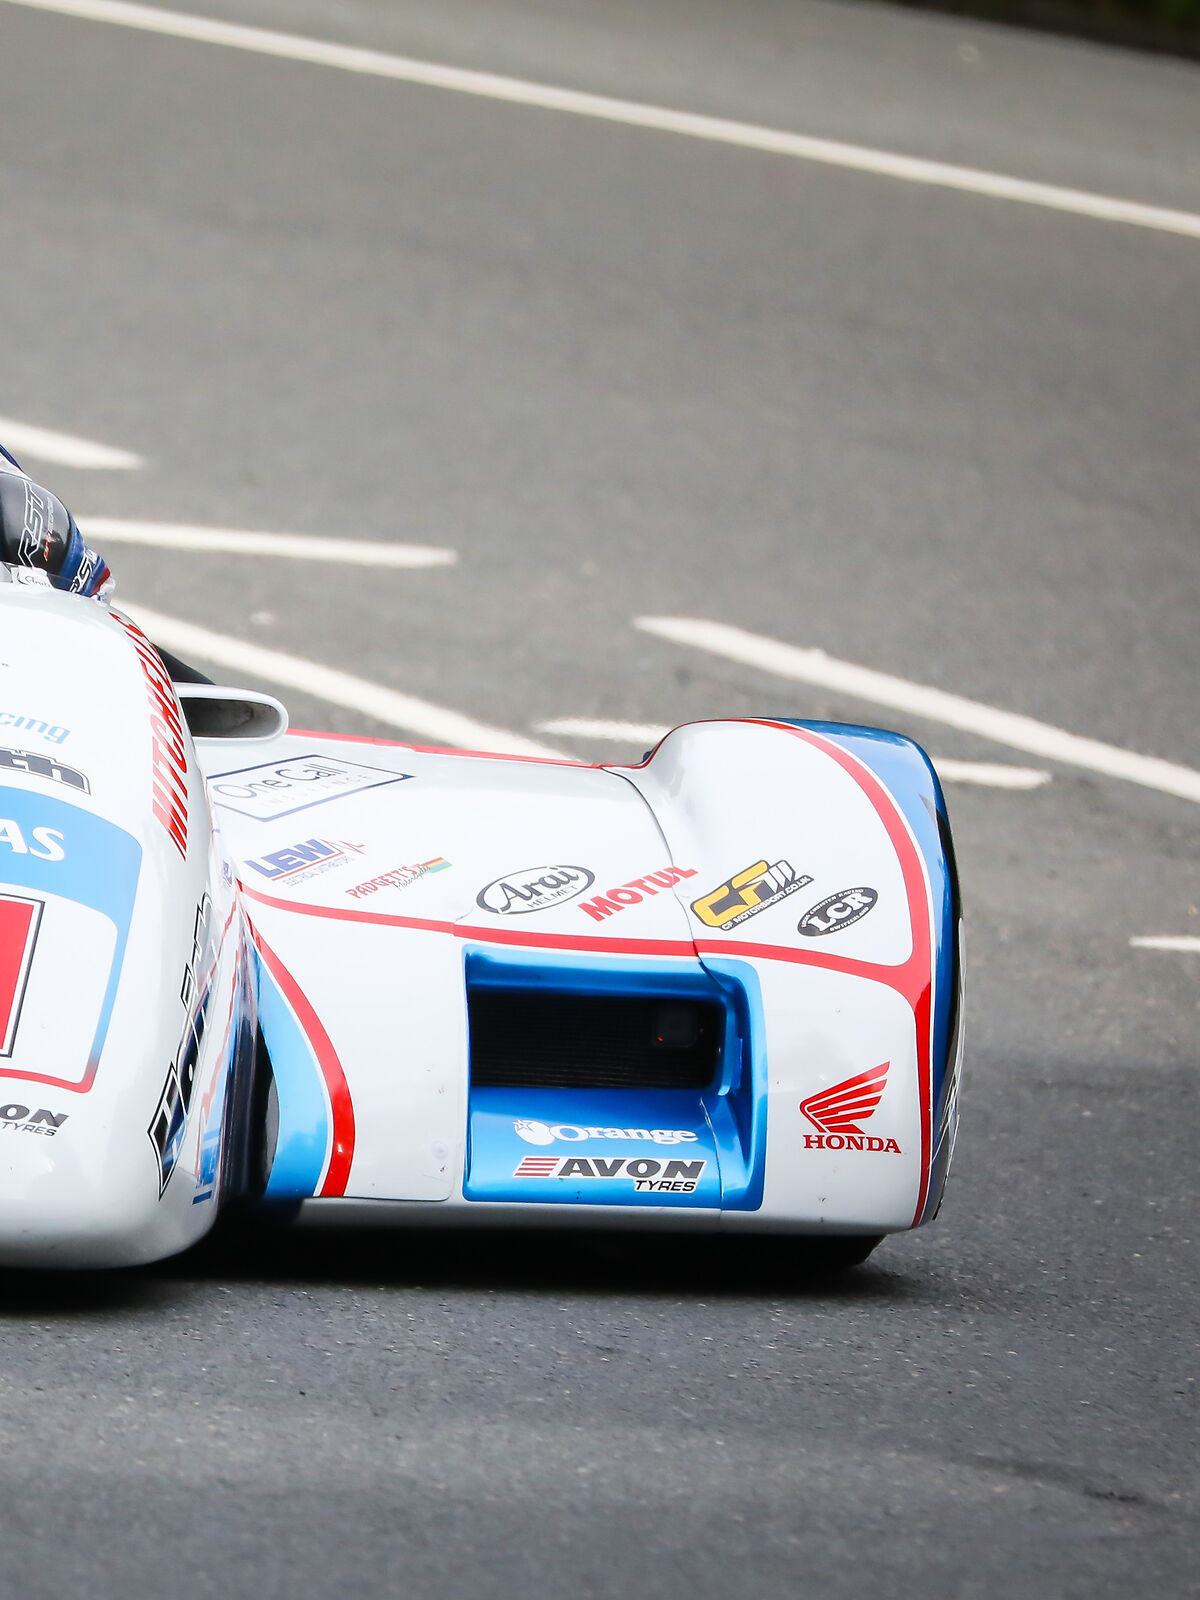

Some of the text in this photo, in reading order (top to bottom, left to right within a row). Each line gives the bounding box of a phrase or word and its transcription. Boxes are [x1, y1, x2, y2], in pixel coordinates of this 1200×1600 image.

[212, 763, 348, 799] One Call
[243, 838, 336, 879] LEW
[344, 865, 418, 899] PADGETT'S
[497, 865, 580, 913] Arai
[526, 885, 578, 909] HELMET
[578, 865, 699, 923] MOTUL
[734, 876, 812, 925] MOTORSPORT.CO.UK
[807, 892, 873, 932] LCR
[829, 906, 870, 932] SWITZERLAND
[2, 1121, 57, 1138] TYRES
[548, 1126, 699, 1145] Orange
[802, 1133, 902, 1154] HONDA
[557, 1159, 706, 1179] AVON
[634, 1180, 698, 1193] TYRES
